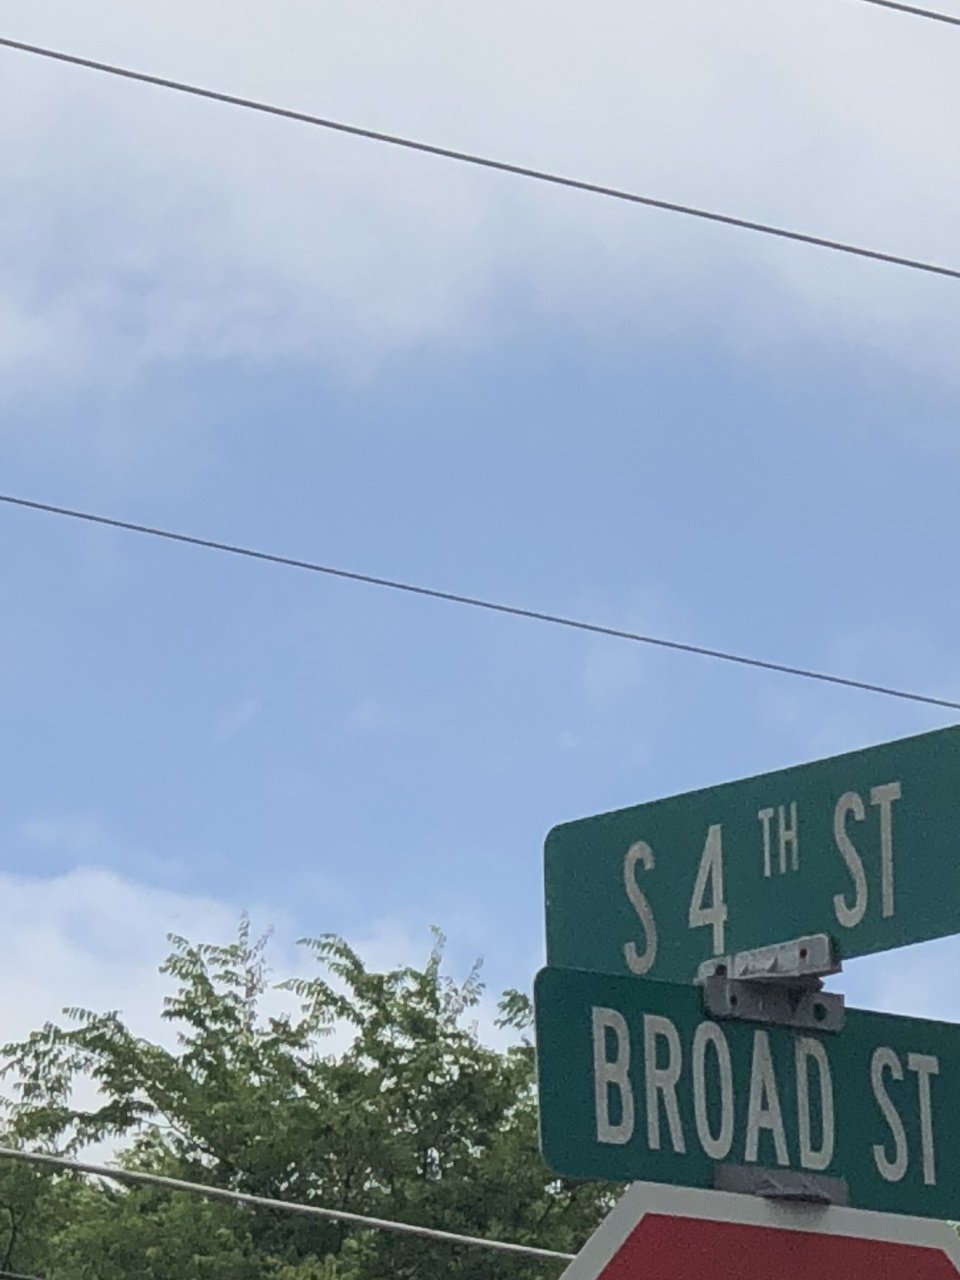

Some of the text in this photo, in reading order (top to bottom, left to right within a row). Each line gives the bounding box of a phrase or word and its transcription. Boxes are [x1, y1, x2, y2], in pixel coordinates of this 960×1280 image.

[623, 840, 658, 975] S
[833, 781, 902, 928] ST
[591, 1006, 940, 1186] BROAD ST
